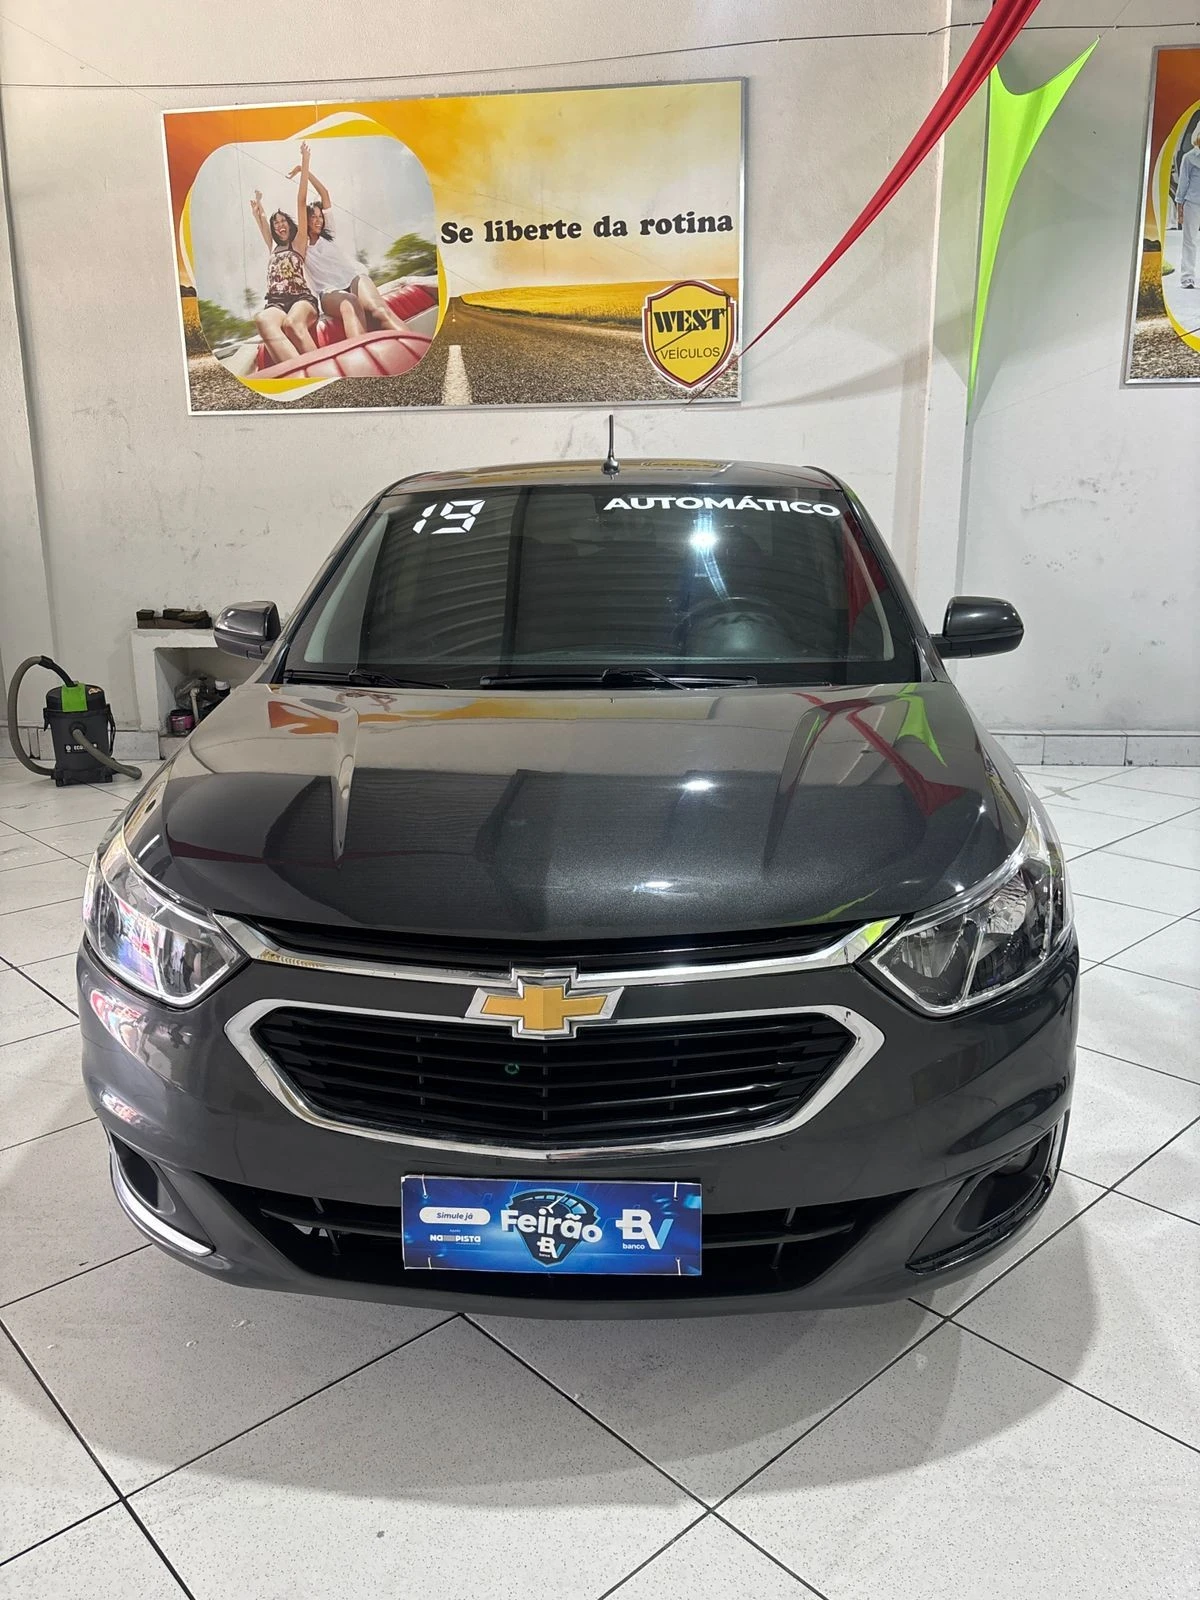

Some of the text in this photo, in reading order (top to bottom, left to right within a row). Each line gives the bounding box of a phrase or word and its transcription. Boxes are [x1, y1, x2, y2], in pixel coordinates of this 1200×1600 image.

[440, 211, 734, 244] Se liberte da rotina
[653, 308, 726, 333] WEST
[660, 347, 721, 360] VEÍCULOS
[412, 499, 486, 535] 19
[603, 495, 841, 517] AUTOMÁTICO
[436, 1212, 474, 1221] Simule já
[500, 1208, 603, 1243] Feirão
[615, 1208, 674, 1250] BV
[536, 1236, 566, 1259] BV
[622, 1242, 646, 1250] banco
